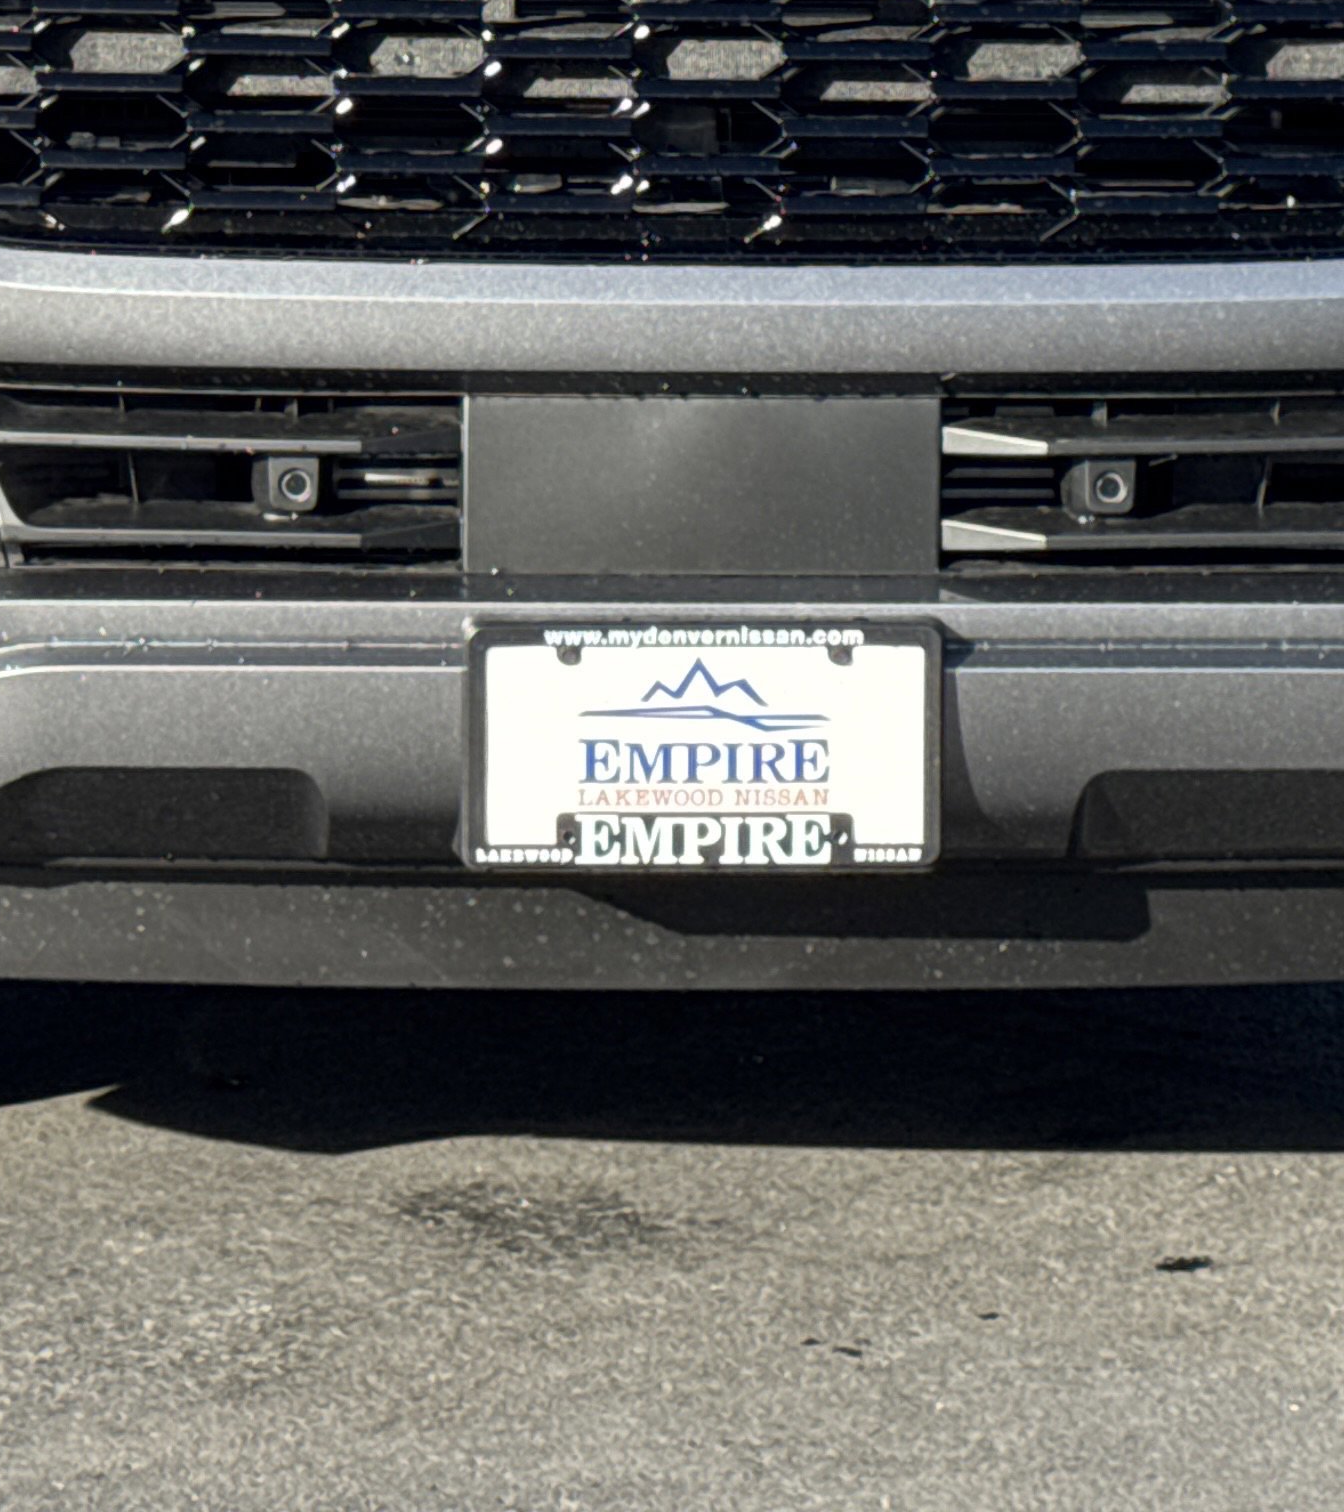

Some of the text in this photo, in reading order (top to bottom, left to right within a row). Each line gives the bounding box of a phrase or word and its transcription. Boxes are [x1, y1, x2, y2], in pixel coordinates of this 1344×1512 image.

[544, 626, 865, 648] www.mydenvernissan.com
[578, 739, 831, 784] EMPIRE
[578, 789, 830, 807] LAKEWOOD NISSAN
[575, 813, 832, 866] EMPIRE
